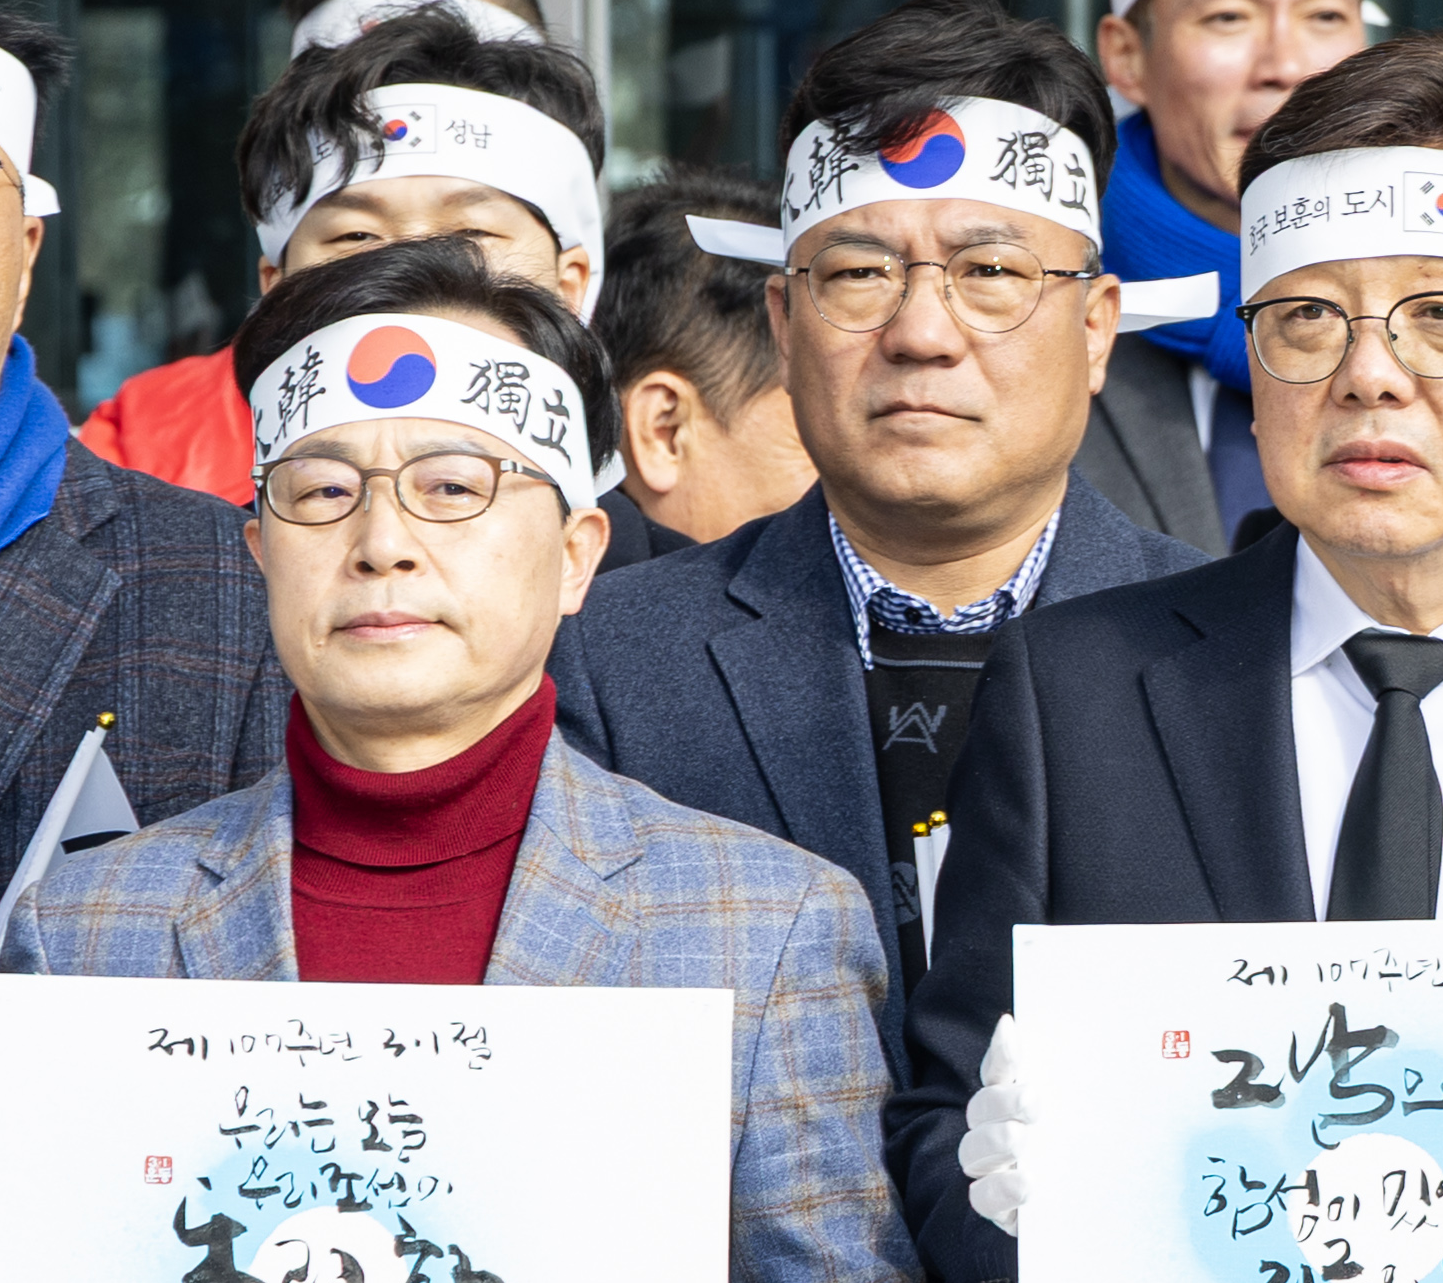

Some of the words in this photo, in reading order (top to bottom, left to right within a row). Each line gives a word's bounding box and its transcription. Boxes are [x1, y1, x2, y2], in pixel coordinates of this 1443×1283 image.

[446, 119, 493, 150] 성남
[989, 130, 1092, 220] 獨立
[1341, 185, 1395, 218] 도시
[459, 357, 573, 470] 獨立
[219, 1085, 336, 1154] 우리는
[358, 1092, 427, 1164] 오늘
[1201, 1156, 1360, 1246] 함성이
